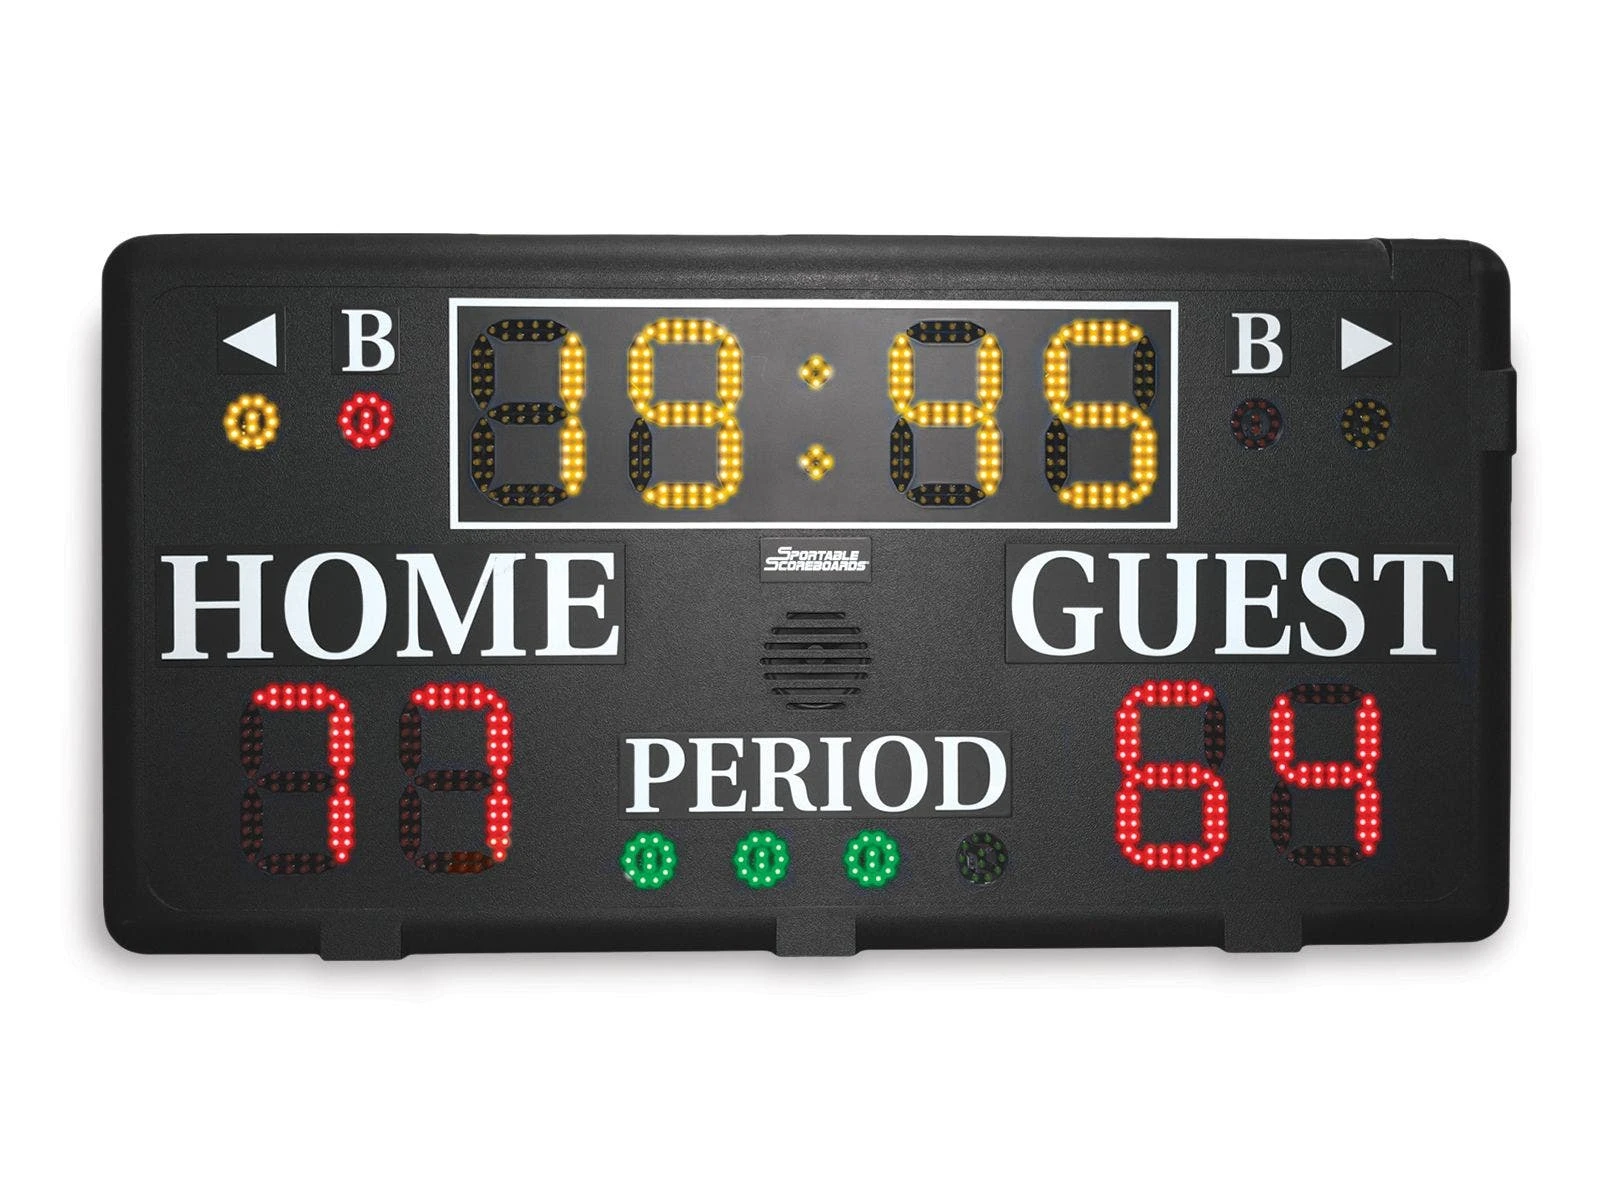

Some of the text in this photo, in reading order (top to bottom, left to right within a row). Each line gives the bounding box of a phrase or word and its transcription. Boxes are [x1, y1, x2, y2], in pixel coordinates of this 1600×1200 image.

[342, 309, 395, 372] B
[1231, 312, 1284, 375] B
[763, 558, 870, 572] SCOREBOARDS
[766, 546, 860, 561] SPORTABLE
[160, 551, 620, 661] HOME
[1011, 550, 1454, 657] GUEST
[252, 682, 516, 864] 77
[625, 735, 1007, 813] PERIOD
[1113, 679, 1382, 871] 64
